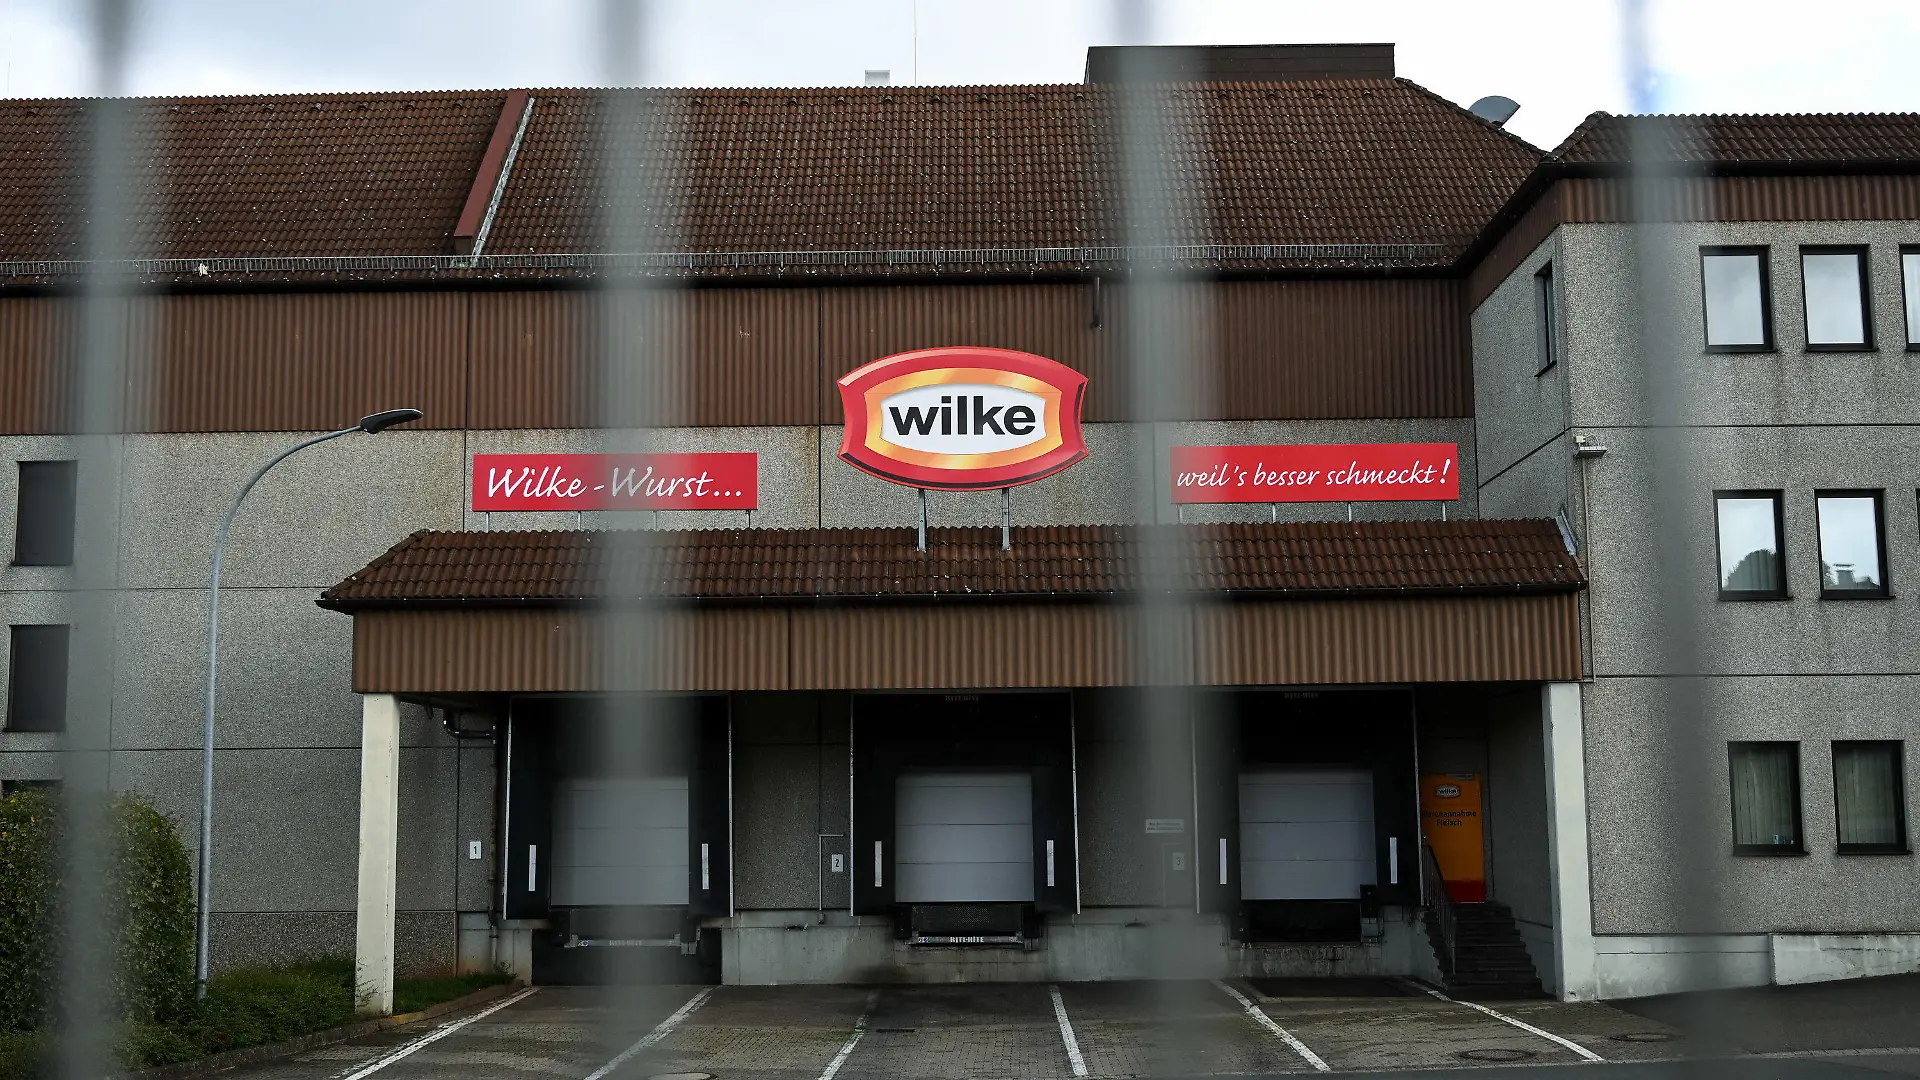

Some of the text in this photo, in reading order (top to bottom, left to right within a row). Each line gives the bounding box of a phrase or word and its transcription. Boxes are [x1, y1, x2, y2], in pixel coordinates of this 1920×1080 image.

[888, 395, 1036, 437] wilke
[1176, 458, 1452, 487] weil's besser schmeckt!
[1436, 818, 1462, 826] Fleisch
[835, 858, 840, 868] 2
